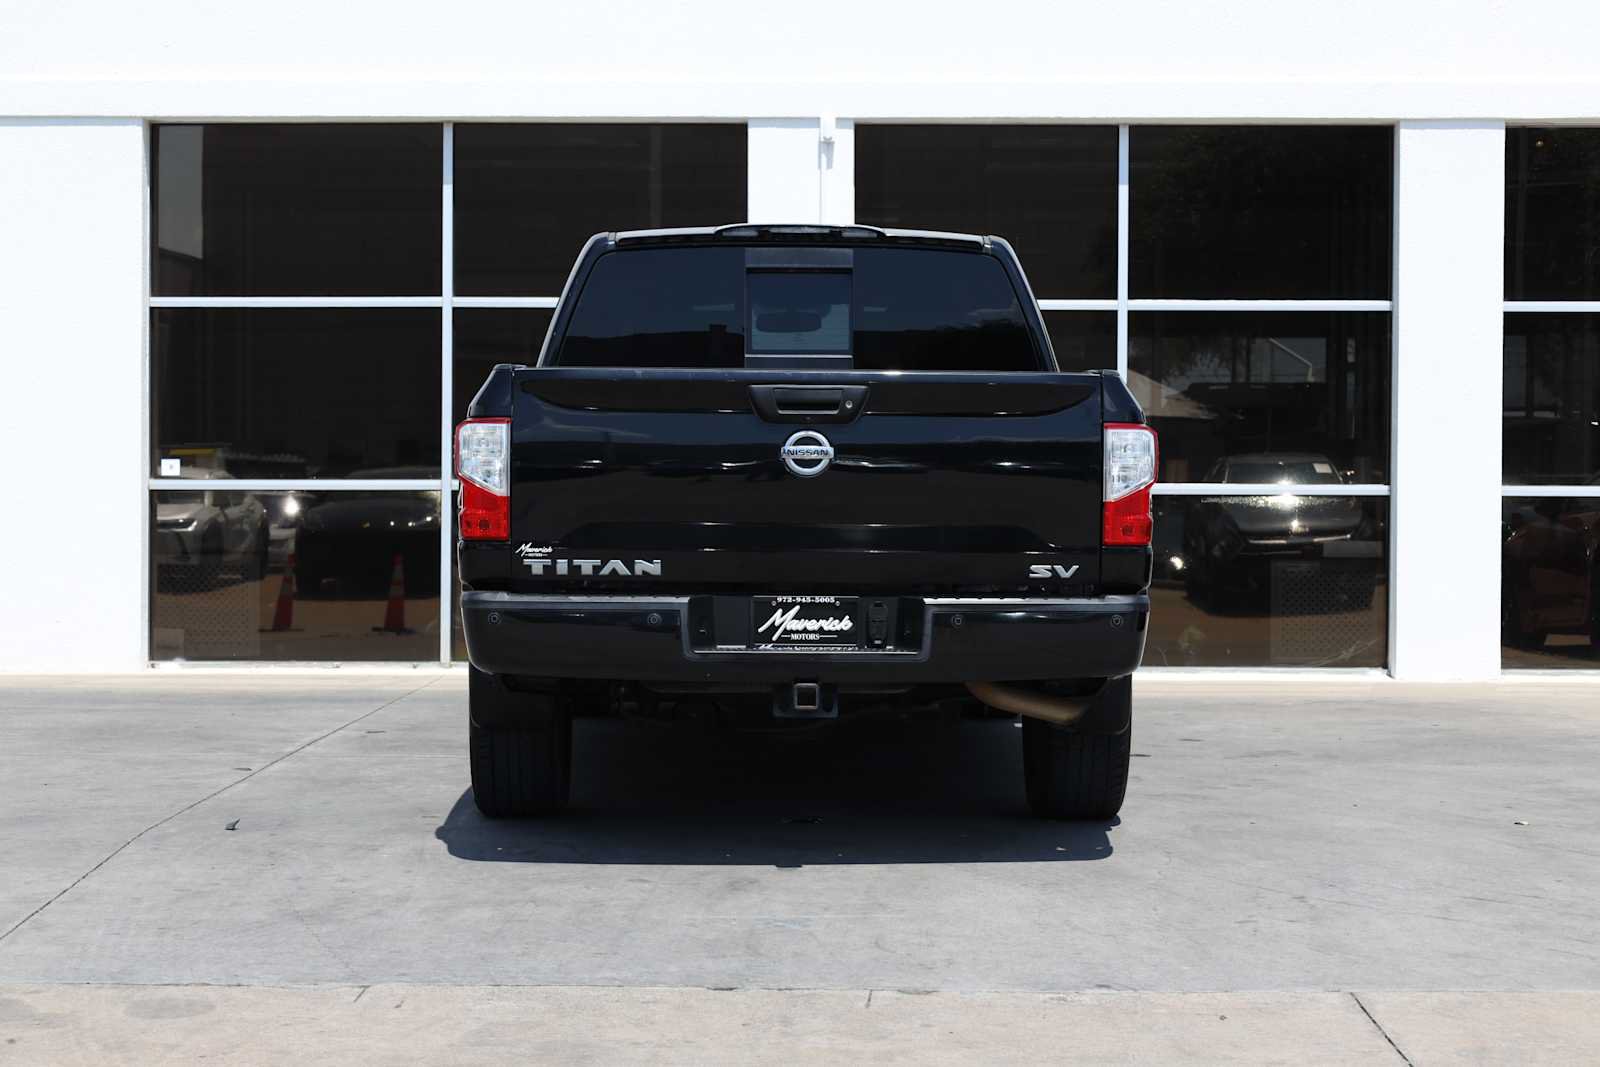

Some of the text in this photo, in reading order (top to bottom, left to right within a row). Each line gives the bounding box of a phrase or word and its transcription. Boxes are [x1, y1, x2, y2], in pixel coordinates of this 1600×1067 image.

[523, 559, 662, 576] TITAN
[1029, 565, 1080, 578] SV
[758, 605, 854, 641] Maverick
[790, 633, 820, 641] MOTORS
